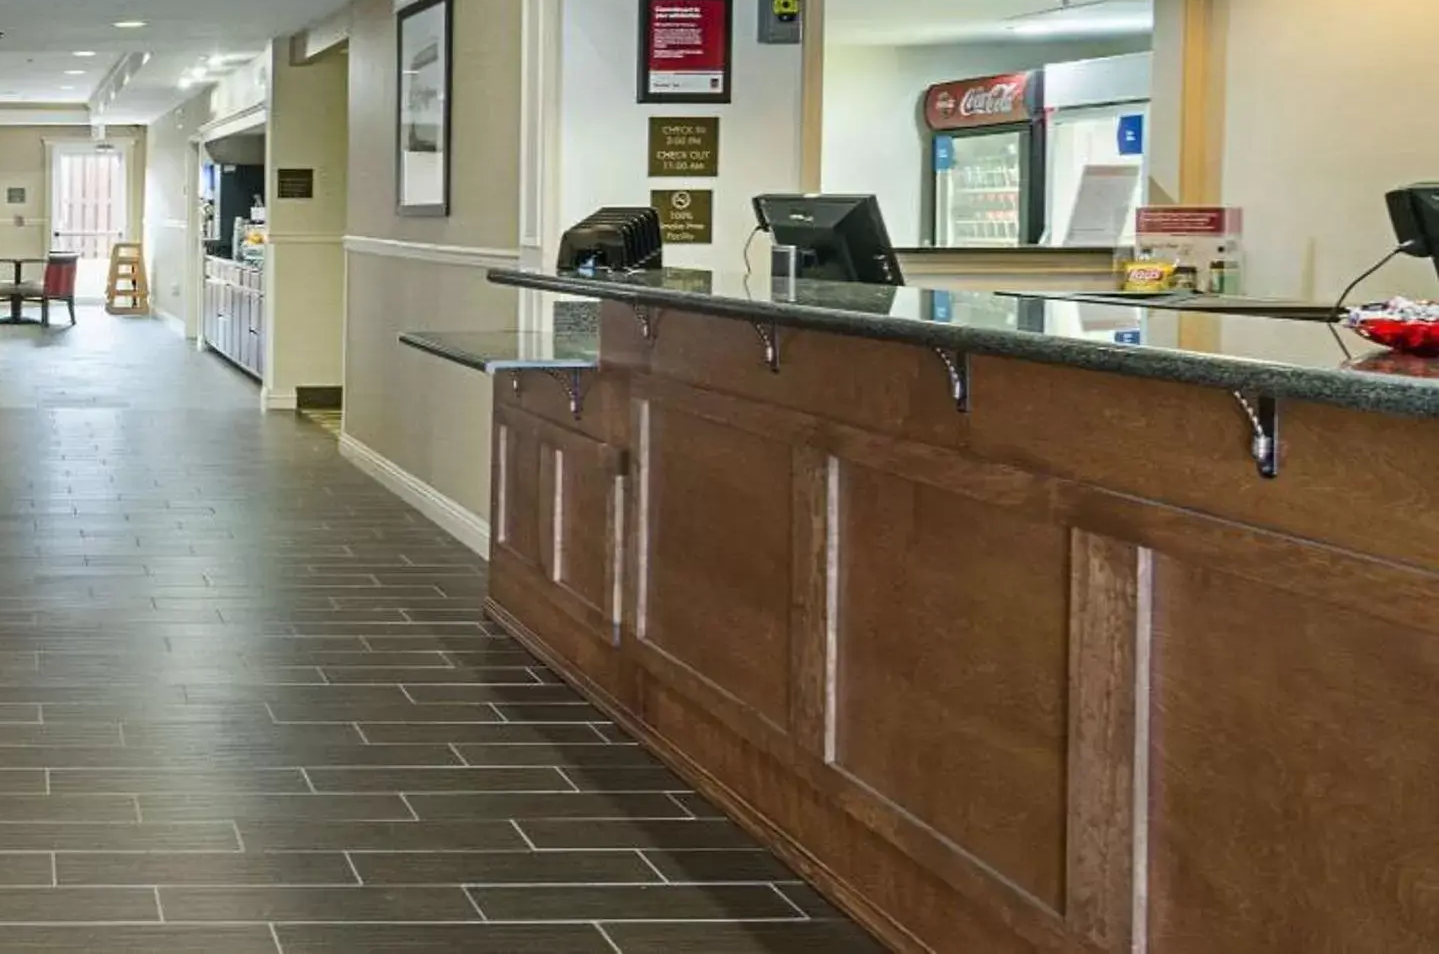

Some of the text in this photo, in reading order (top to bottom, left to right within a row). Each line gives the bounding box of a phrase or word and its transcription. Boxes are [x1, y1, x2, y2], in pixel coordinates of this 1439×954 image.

[661, 126, 693, 135] CHECK
[656, 150, 710, 160] CHECK OUT
[670, 210, 693, 220] 100%
